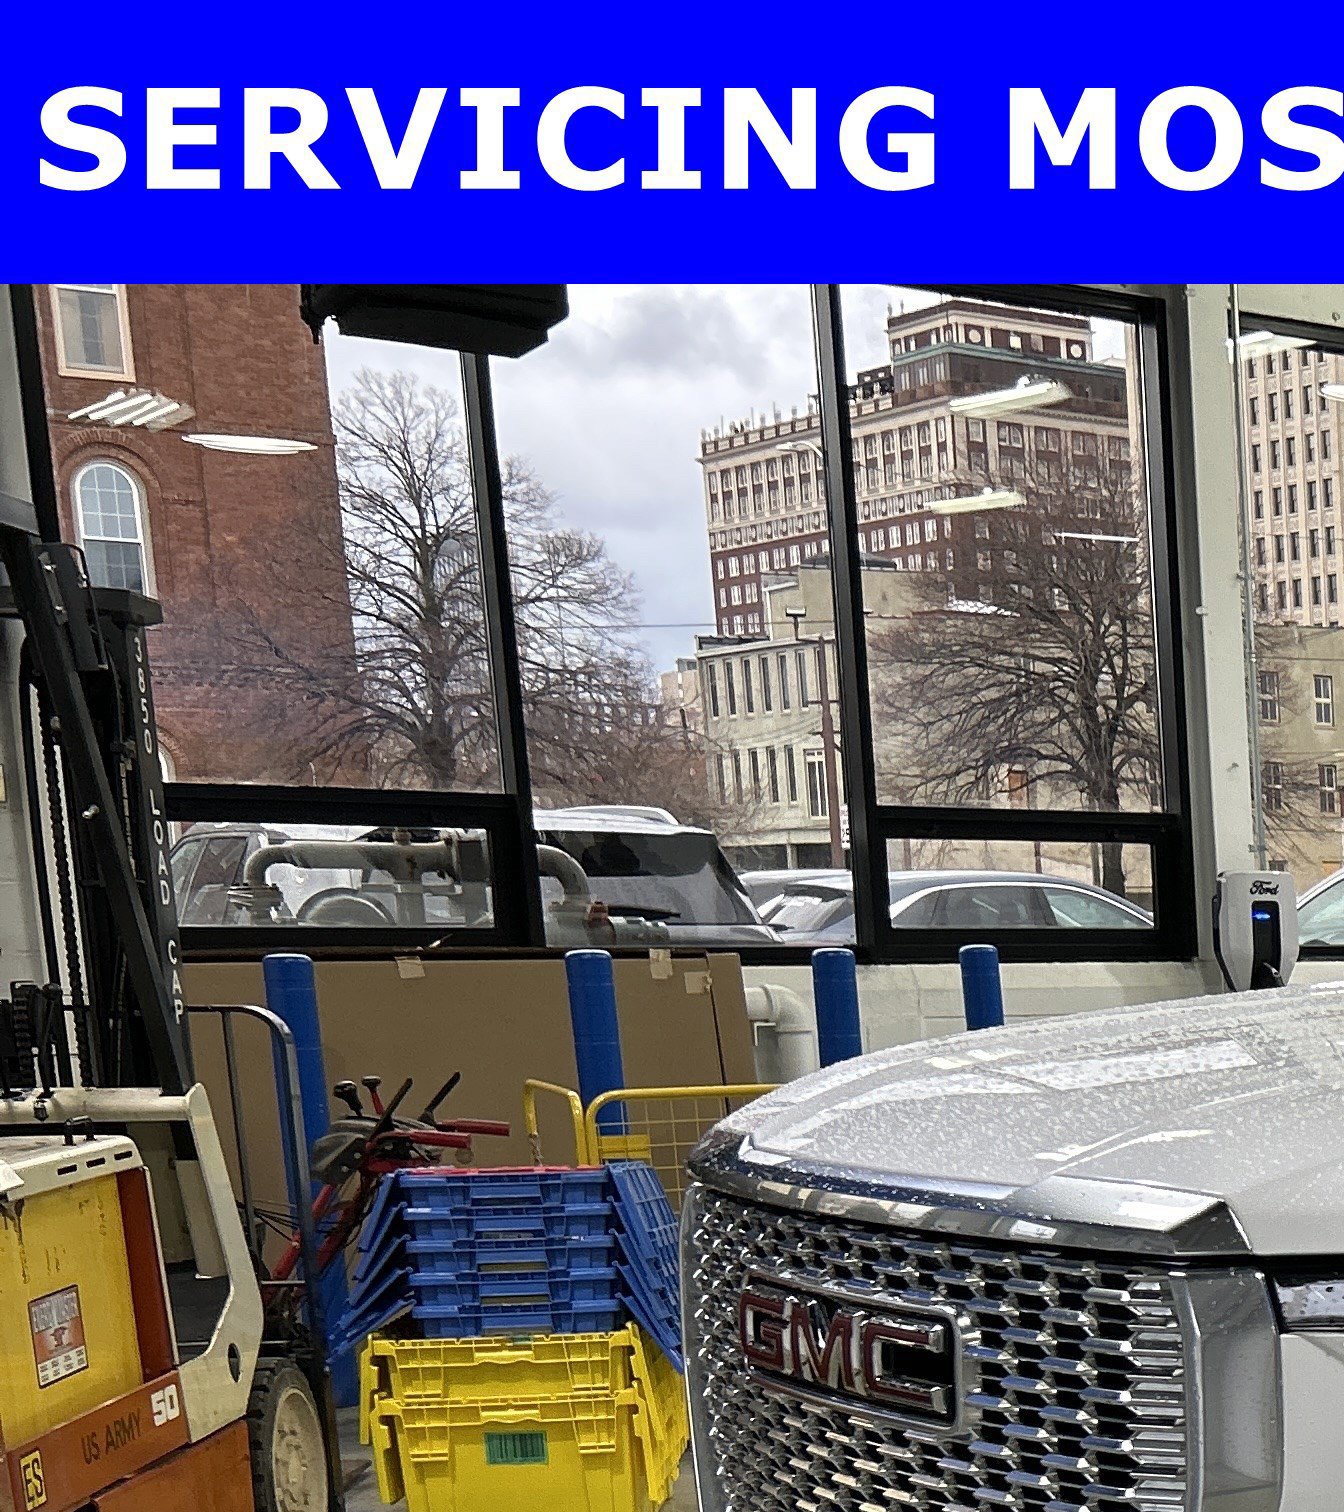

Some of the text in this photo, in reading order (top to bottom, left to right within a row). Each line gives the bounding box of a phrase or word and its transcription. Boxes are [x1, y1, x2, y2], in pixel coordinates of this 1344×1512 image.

[134, 635, 185, 1026] 3850 LOAD CAP
[1250, 880, 1279, 895] Ford
[739, 1286, 950, 1414] GMC
[151, 1384, 181, 1427] 50
[81, 1408, 142, 1465] US ARMY
[22, 1459, 44, 1503] ES
